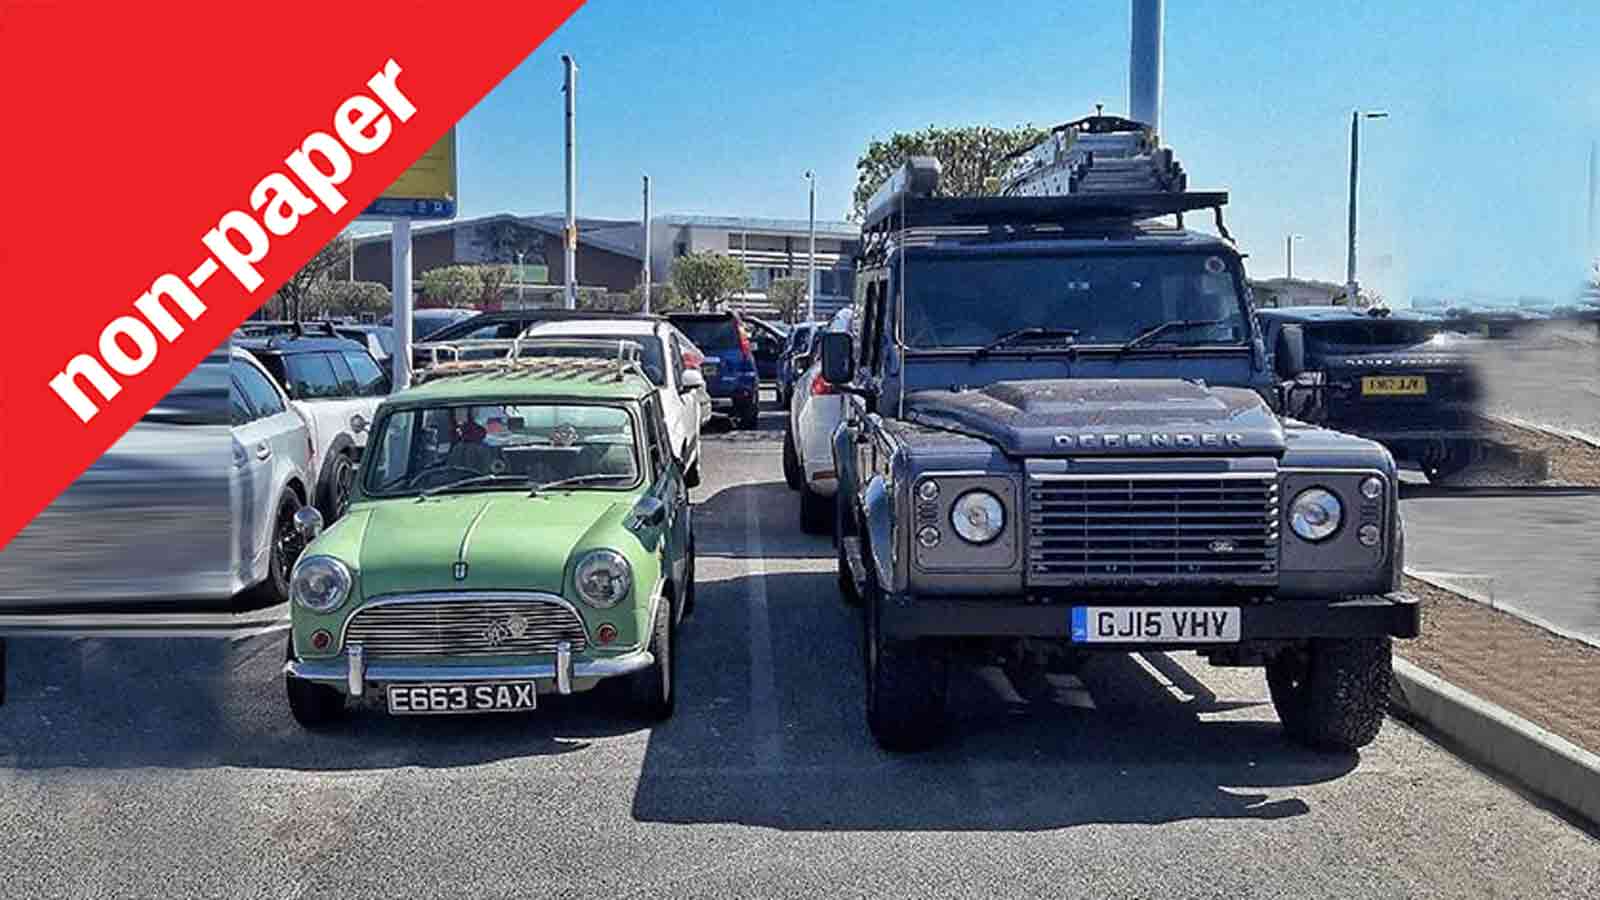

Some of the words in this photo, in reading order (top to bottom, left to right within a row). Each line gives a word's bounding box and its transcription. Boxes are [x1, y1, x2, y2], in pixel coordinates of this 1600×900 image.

[1053, 432, 1244, 448] DEFENDER
[1098, 611, 1162, 637] GJ15
[1172, 611, 1228, 637] VHY
[391, 688, 468, 711] E663
[475, 685, 532, 709] SAX
